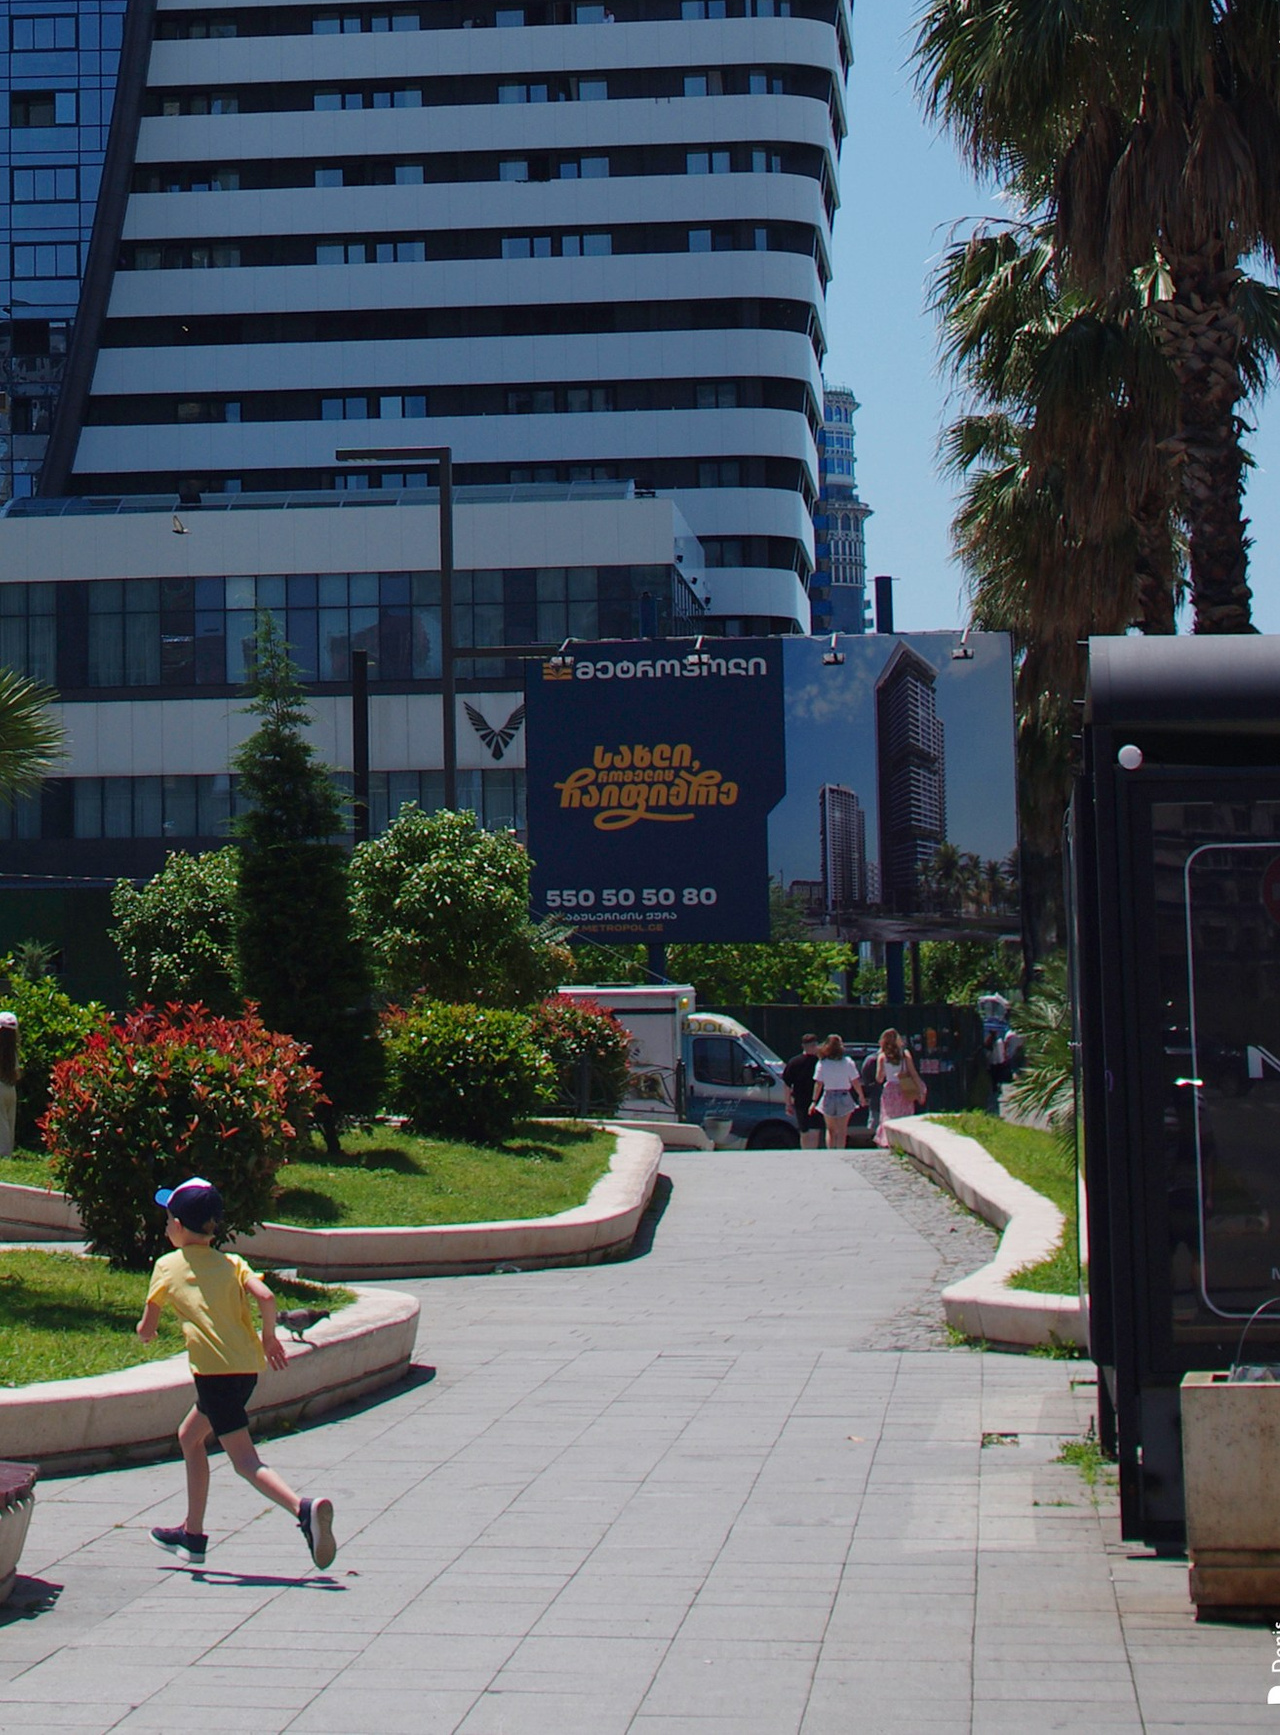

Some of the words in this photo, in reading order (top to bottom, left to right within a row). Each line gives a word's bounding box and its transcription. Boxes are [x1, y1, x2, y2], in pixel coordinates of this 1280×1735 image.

[575, 656, 767, 679] მეტროპოლი
[546, 889, 595, 907] 550
[601, 889, 635, 907] 50
[642, 888, 675, 906] 50
[682, 887, 717, 906] 80
